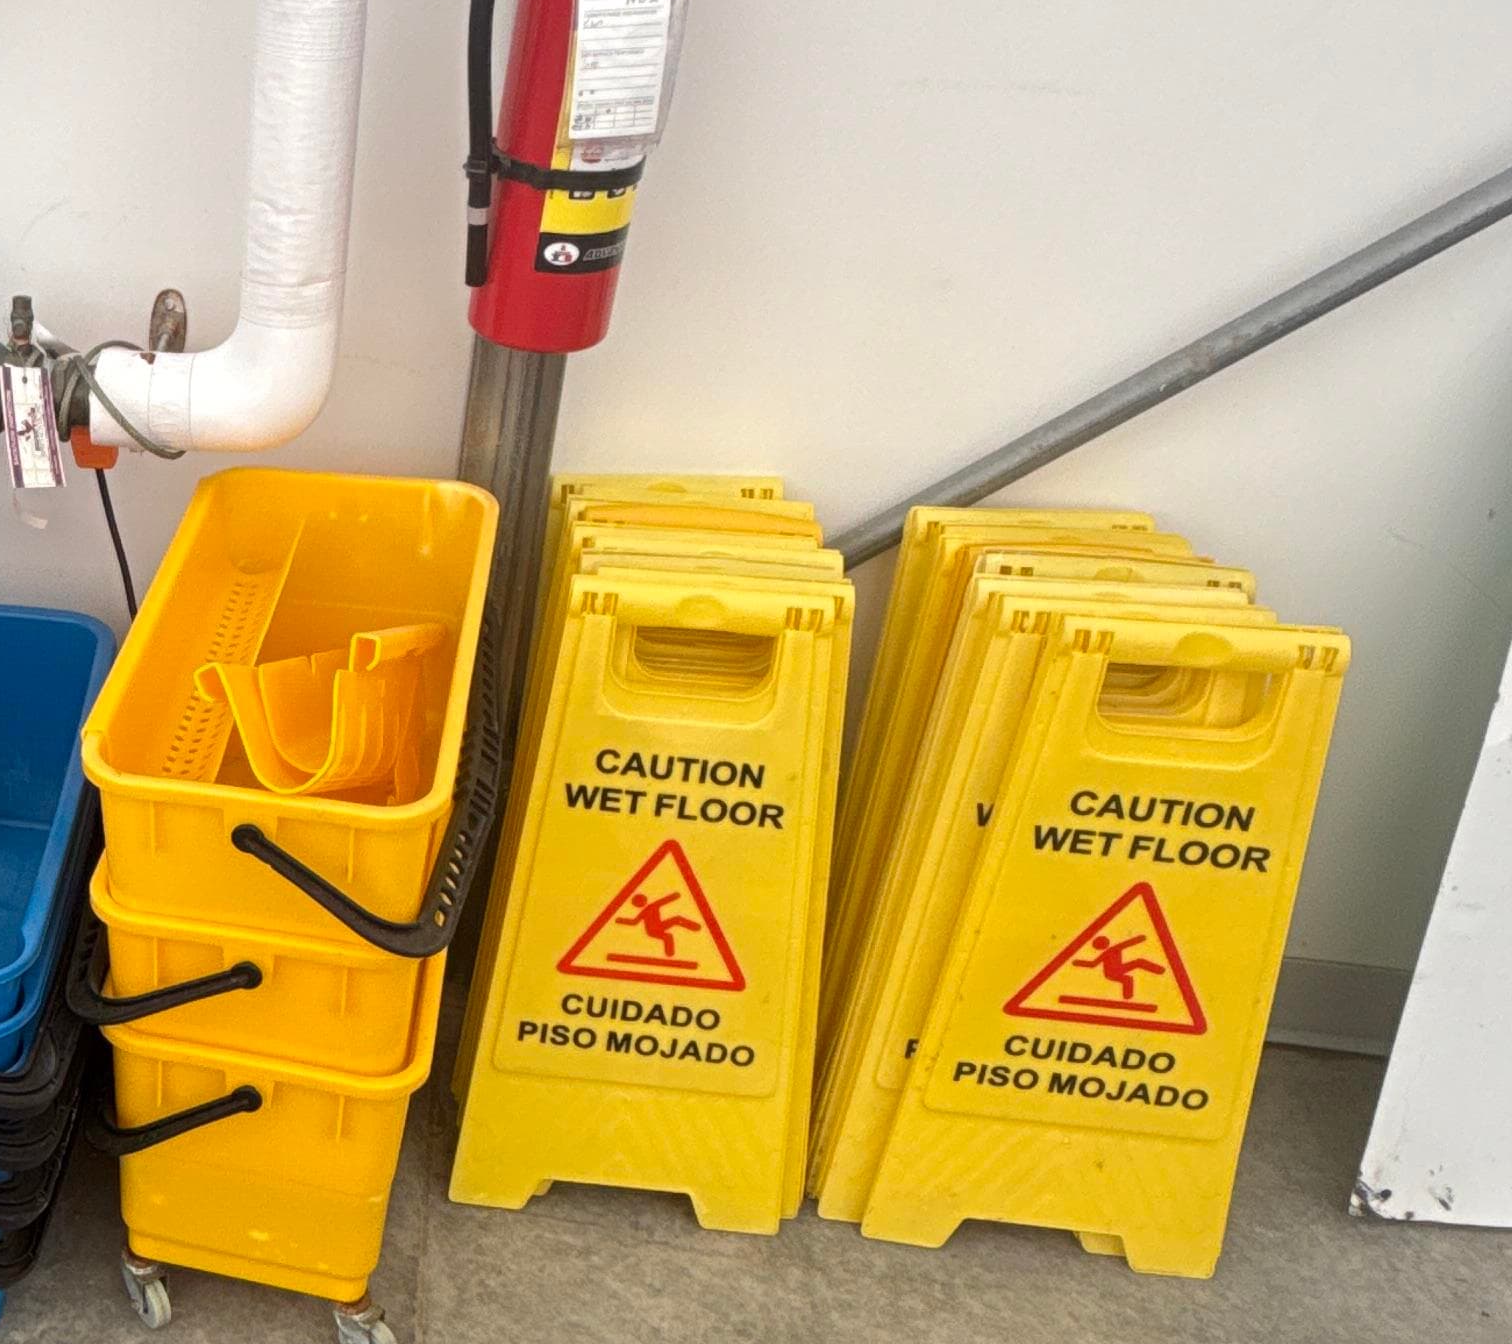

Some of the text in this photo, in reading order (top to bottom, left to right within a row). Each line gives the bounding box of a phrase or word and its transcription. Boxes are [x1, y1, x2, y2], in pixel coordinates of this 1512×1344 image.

[595, 748, 766, 789] CAUTION
[564, 782, 785, 830] WET FLOOR
[1070, 790, 1256, 832] CAUTION
[1033, 825, 1272, 873] WET FLOOR
[560, 992, 721, 1031] CUIDADO
[517, 1020, 756, 1068] PISO MOJADO
[1003, 1035, 1176, 1074] CUIDADO
[952, 1061, 1209, 1111] PISO MOJADO
